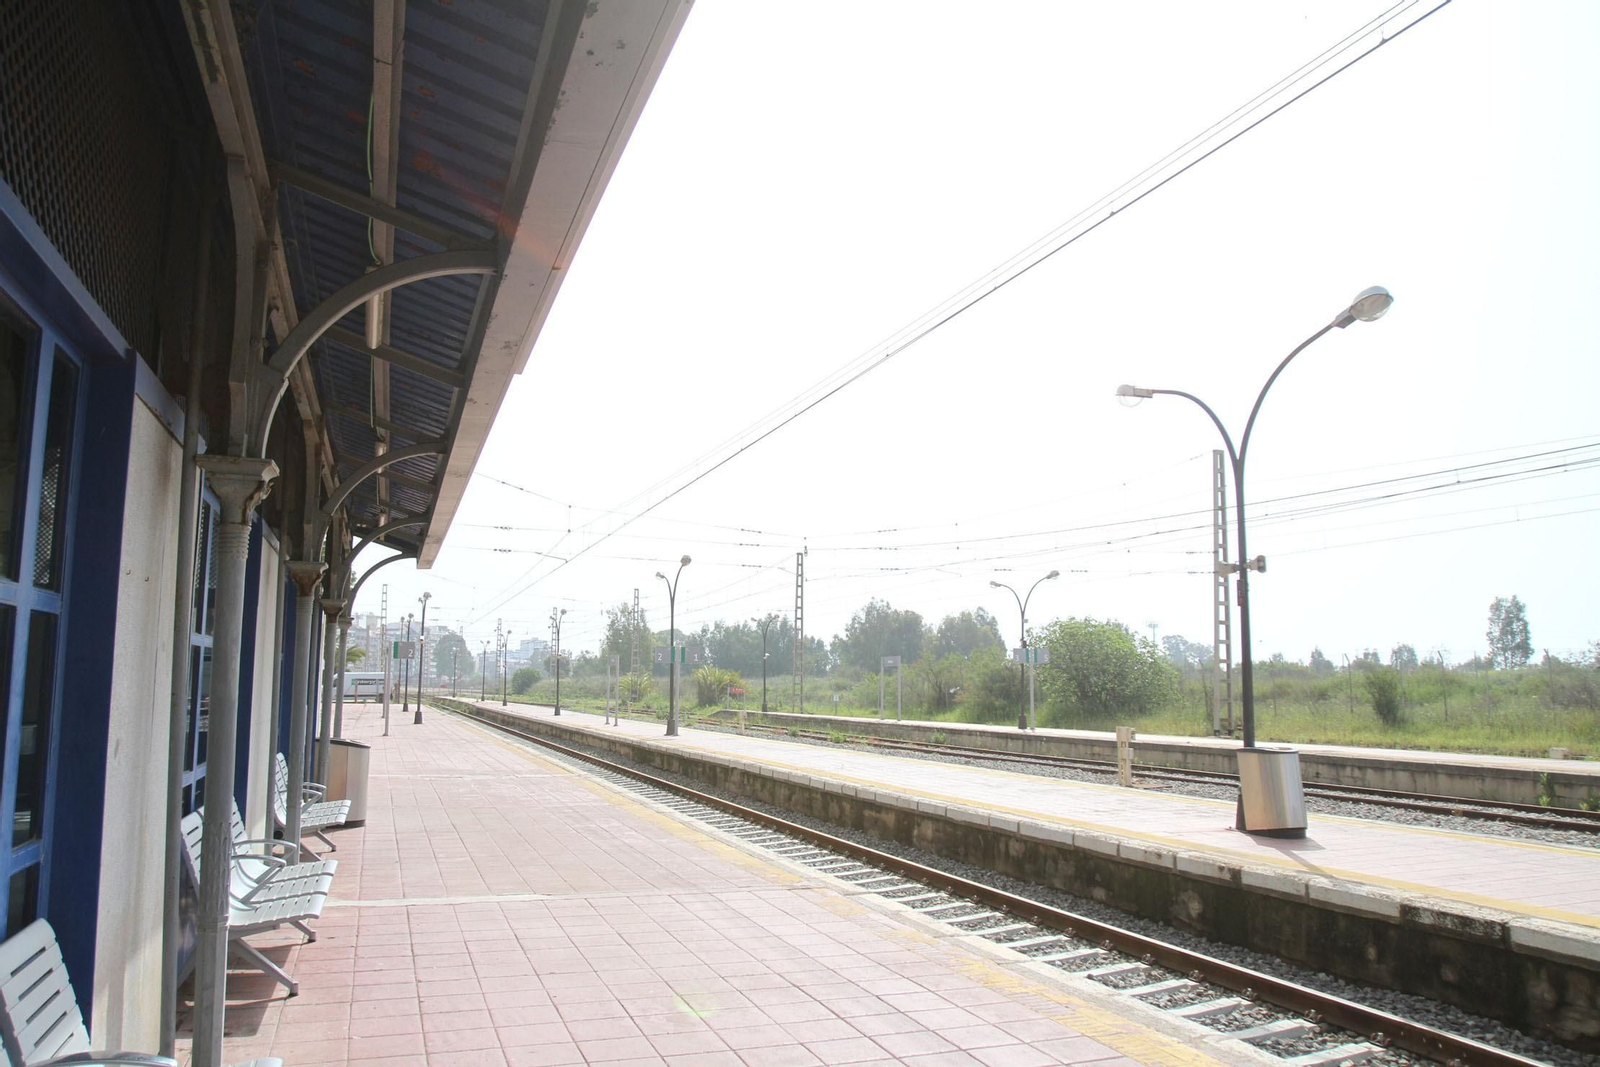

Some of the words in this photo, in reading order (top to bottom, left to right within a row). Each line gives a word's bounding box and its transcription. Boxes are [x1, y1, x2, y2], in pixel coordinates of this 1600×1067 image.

[408, 648, 414, 658] 2
[657, 652, 663, 661] 2
[693, 653, 699, 662] 1
